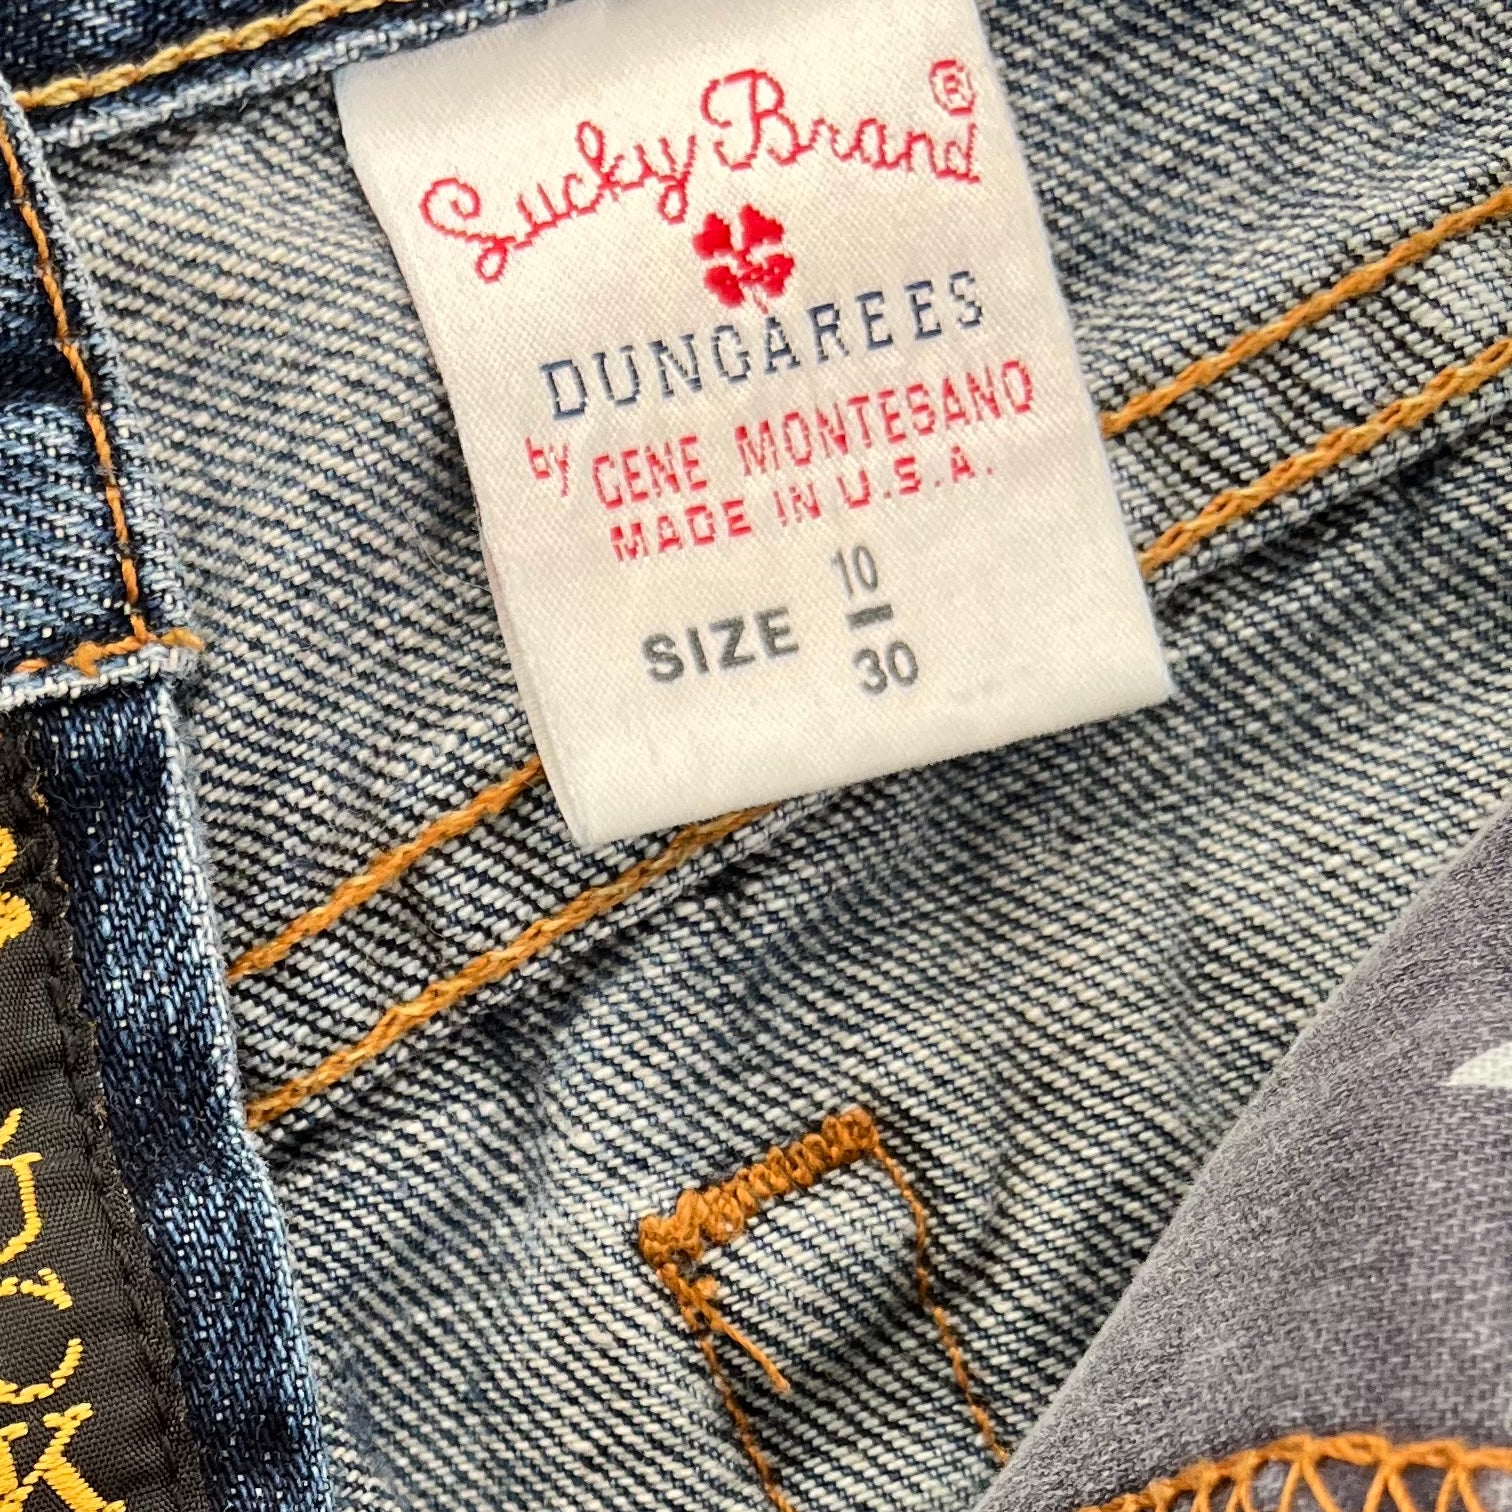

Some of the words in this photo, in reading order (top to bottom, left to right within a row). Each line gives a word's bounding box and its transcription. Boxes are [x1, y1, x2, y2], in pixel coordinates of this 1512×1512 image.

[420, 121, 696, 282] Lucky
[700, 69, 980, 183] Brand
[539, 270, 984, 420] DUNGAREES
[524, 437, 570, 498] by
[733, 360, 1034, 477] MONTESANO
[609, 499, 753, 562] MADE
[774, 484, 822, 527] IN
[836, 446, 995, 510] U.S.A.
[831, 545, 880, 598] 10
[642, 606, 800, 682] SIZE
[852, 640, 920, 695] 30
